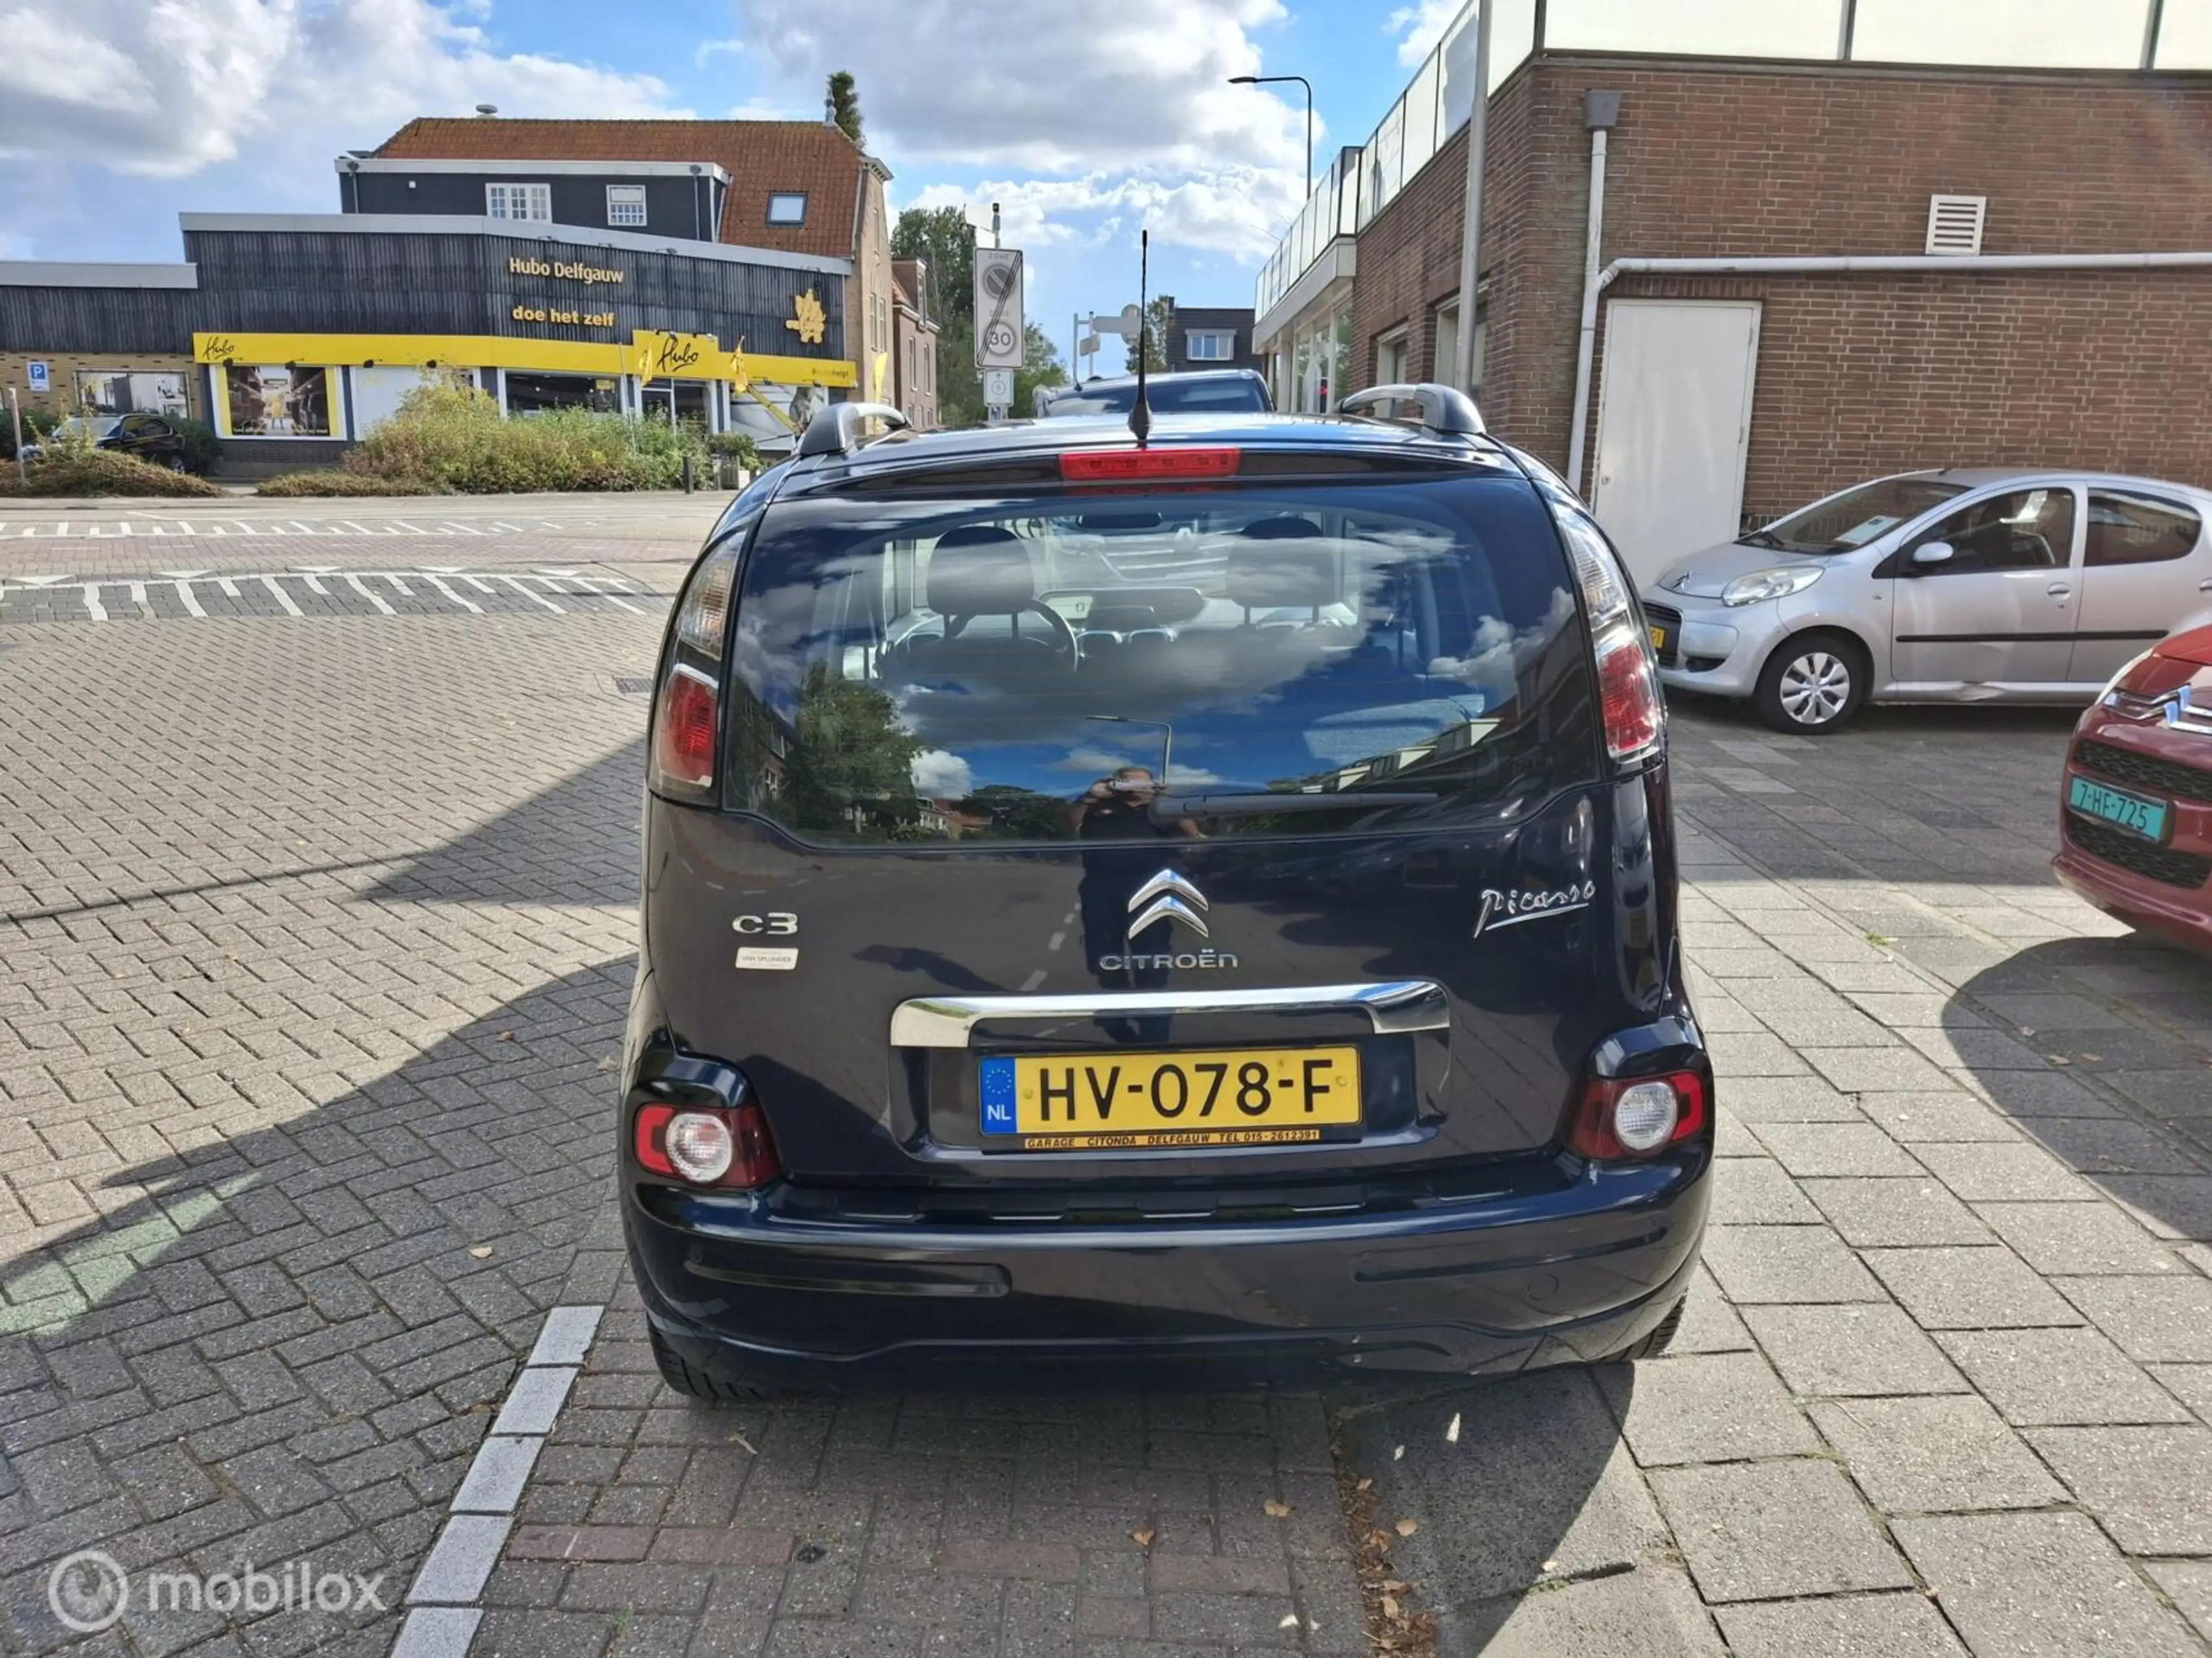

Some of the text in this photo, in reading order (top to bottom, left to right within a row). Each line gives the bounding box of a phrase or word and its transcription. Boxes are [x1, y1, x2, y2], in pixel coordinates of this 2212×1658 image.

[509, 257, 624, 284] Hubo Delfgauw
[512, 305, 615, 327] doe het zelf
[202, 335, 235, 360] Hubo
[990, 332, 1011, 346] 30
[656, 336, 699, 373] Hubo
[33, 366, 43, 378] P
[2080, 783, 2148, 830] 7-HF-725
[1473, 880, 1596, 939] Picasso
[732, 912, 798, 935] C3
[1040, 1059, 1333, 1121] HV-078-F
[987, 1104, 1012, 1120] NL
[1027, 1138, 1076, 1148] GARAGE
[1086, 1136, 1136, 1146] CITONDA
[1147, 1134, 1211, 1145] DELFGAUW
[1219, 1132, 1240, 1142] TEL
